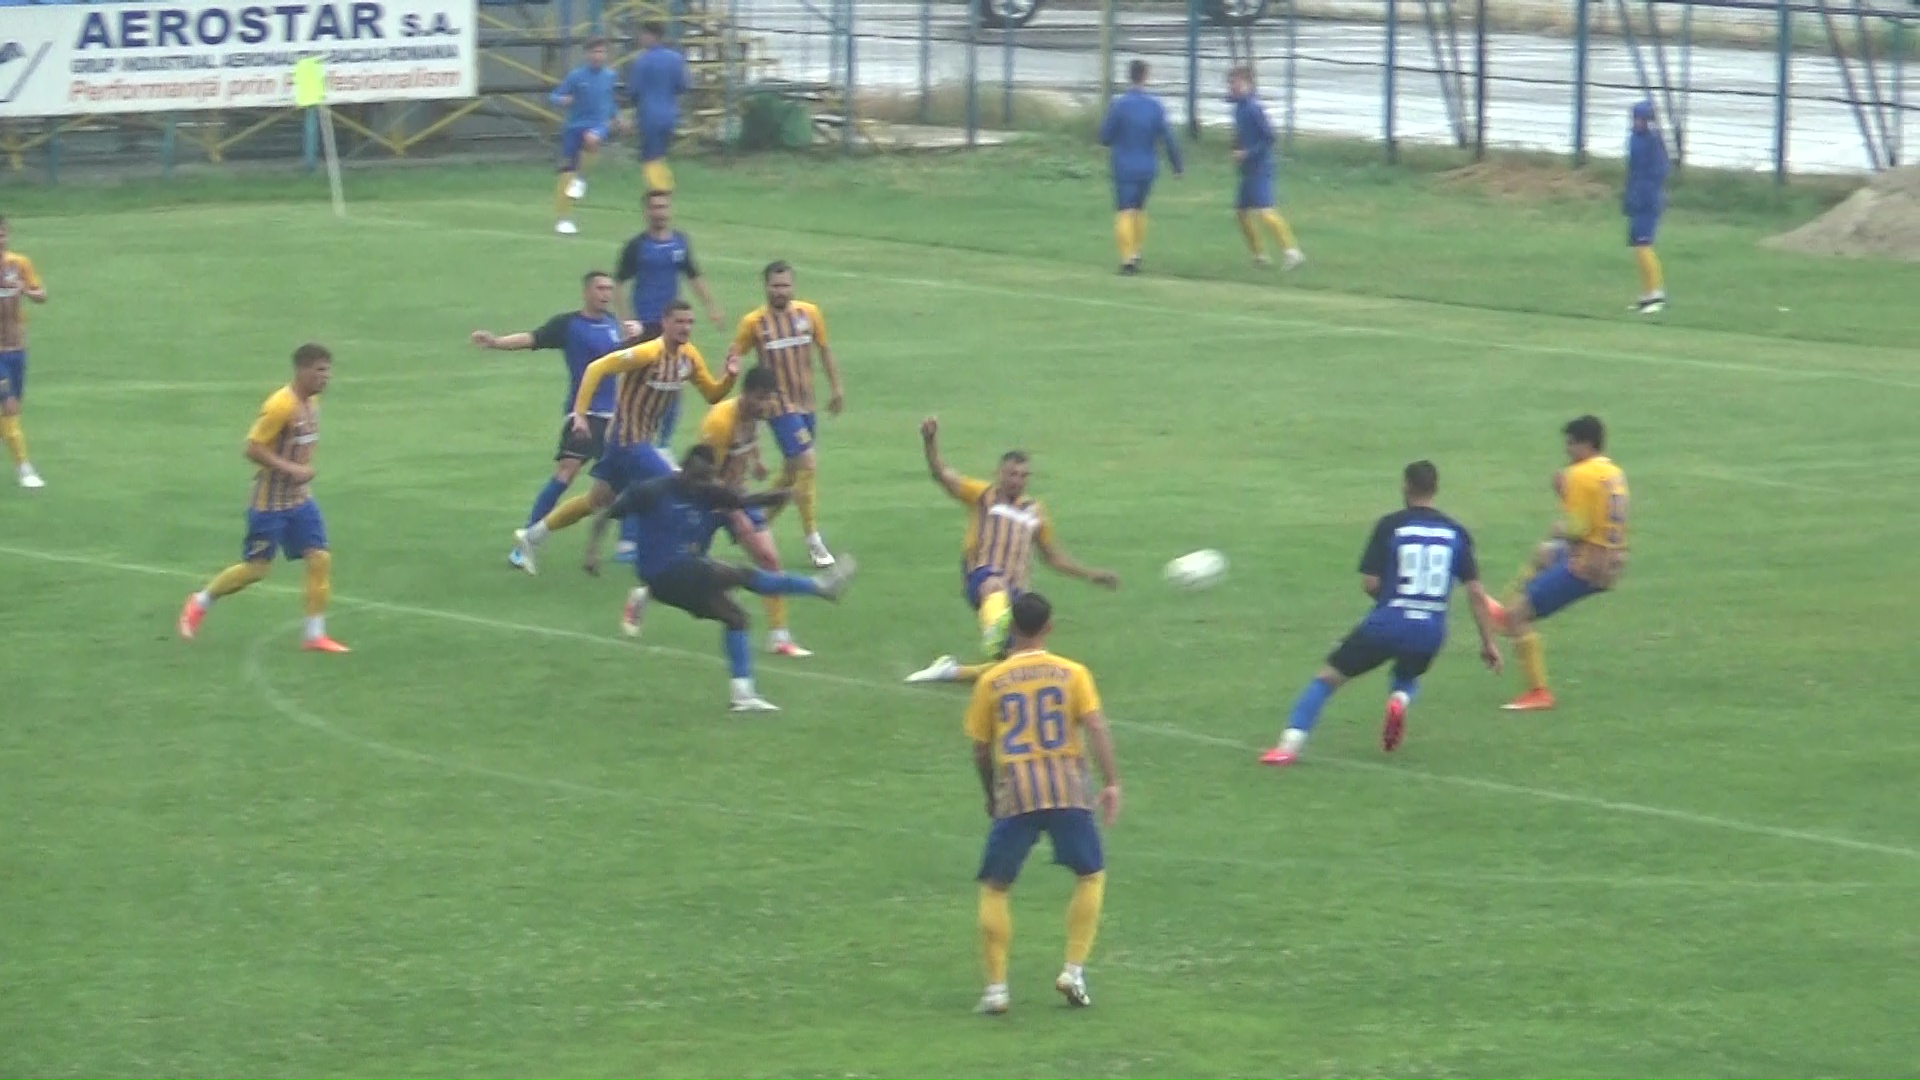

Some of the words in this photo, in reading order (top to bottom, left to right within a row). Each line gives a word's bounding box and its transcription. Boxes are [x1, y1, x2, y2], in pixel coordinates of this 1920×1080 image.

[76, 2, 384, 49] AEROSTAR
[401, 12, 461, 37] S.A.
[121, 54, 217, 72] INDUSTRIAL
[226, 73, 276, 100] prin
[1396, 543, 1452, 597] 98
[1000, 686, 1067, 755] 26
